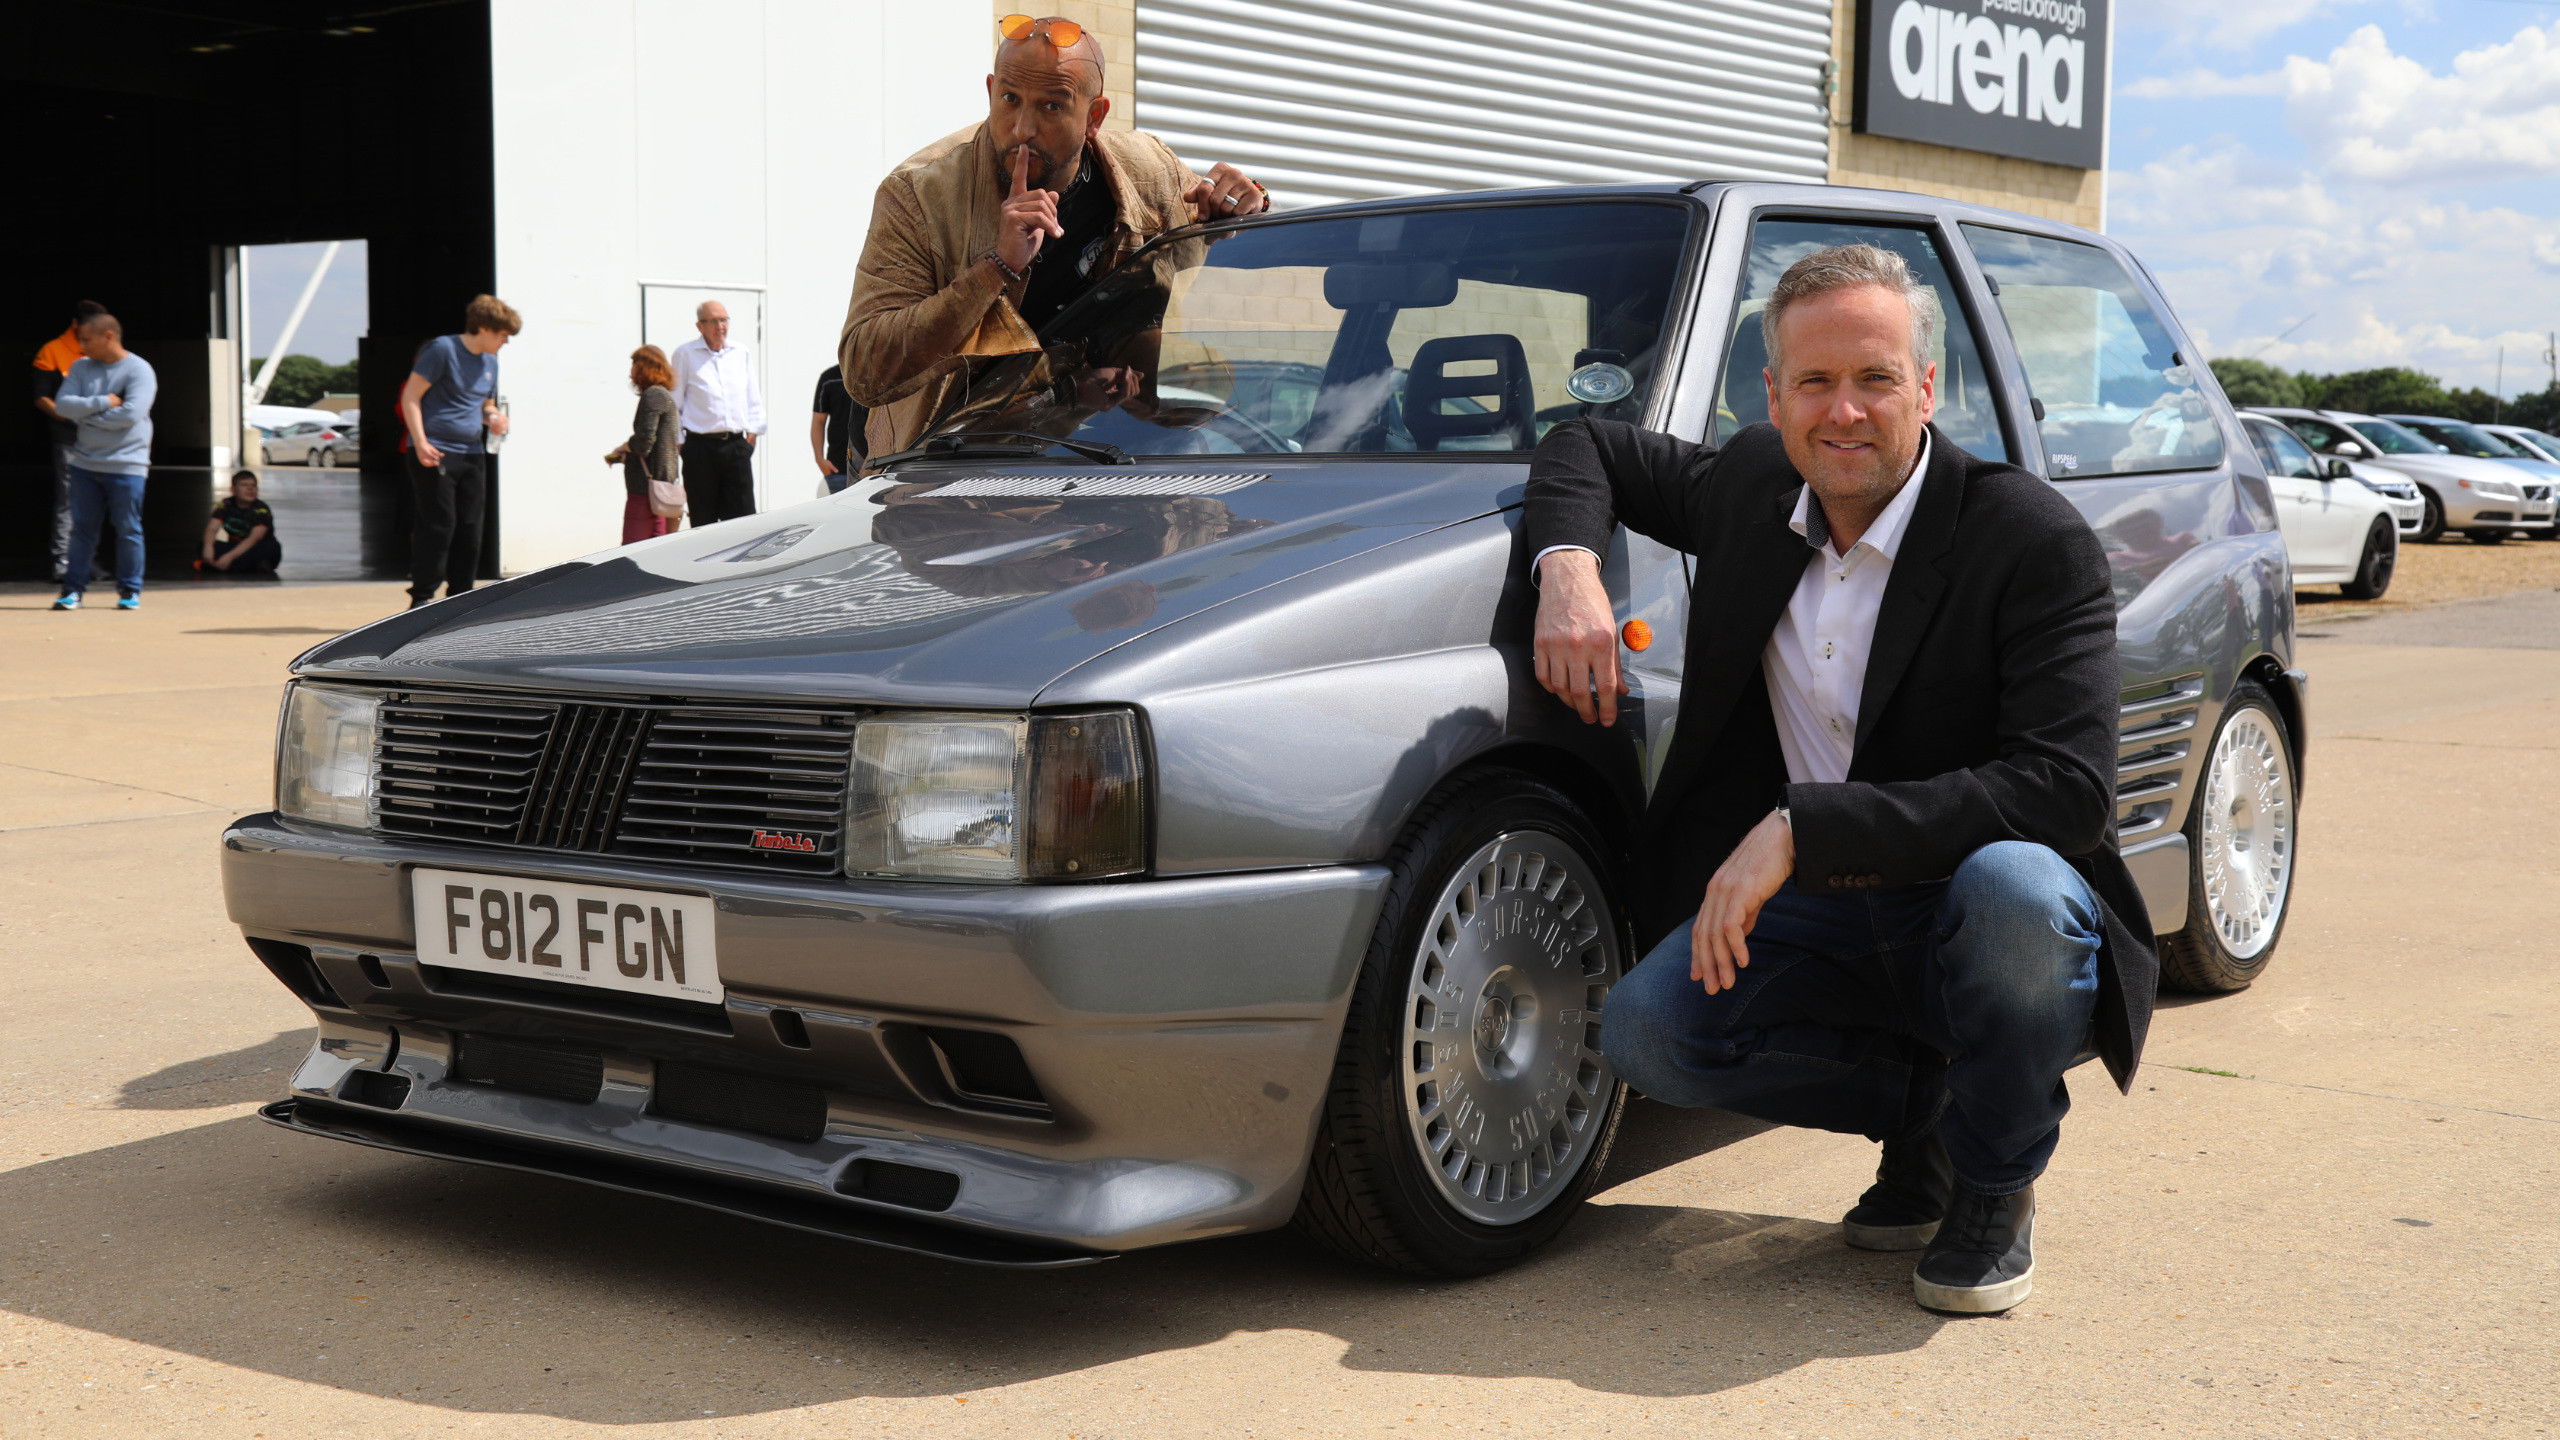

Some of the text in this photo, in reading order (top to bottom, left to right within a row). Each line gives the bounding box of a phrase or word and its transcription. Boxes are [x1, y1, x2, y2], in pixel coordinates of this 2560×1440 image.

[1889, 0, 2085, 129] arena
[445, 884, 686, 985] F812 FGN
